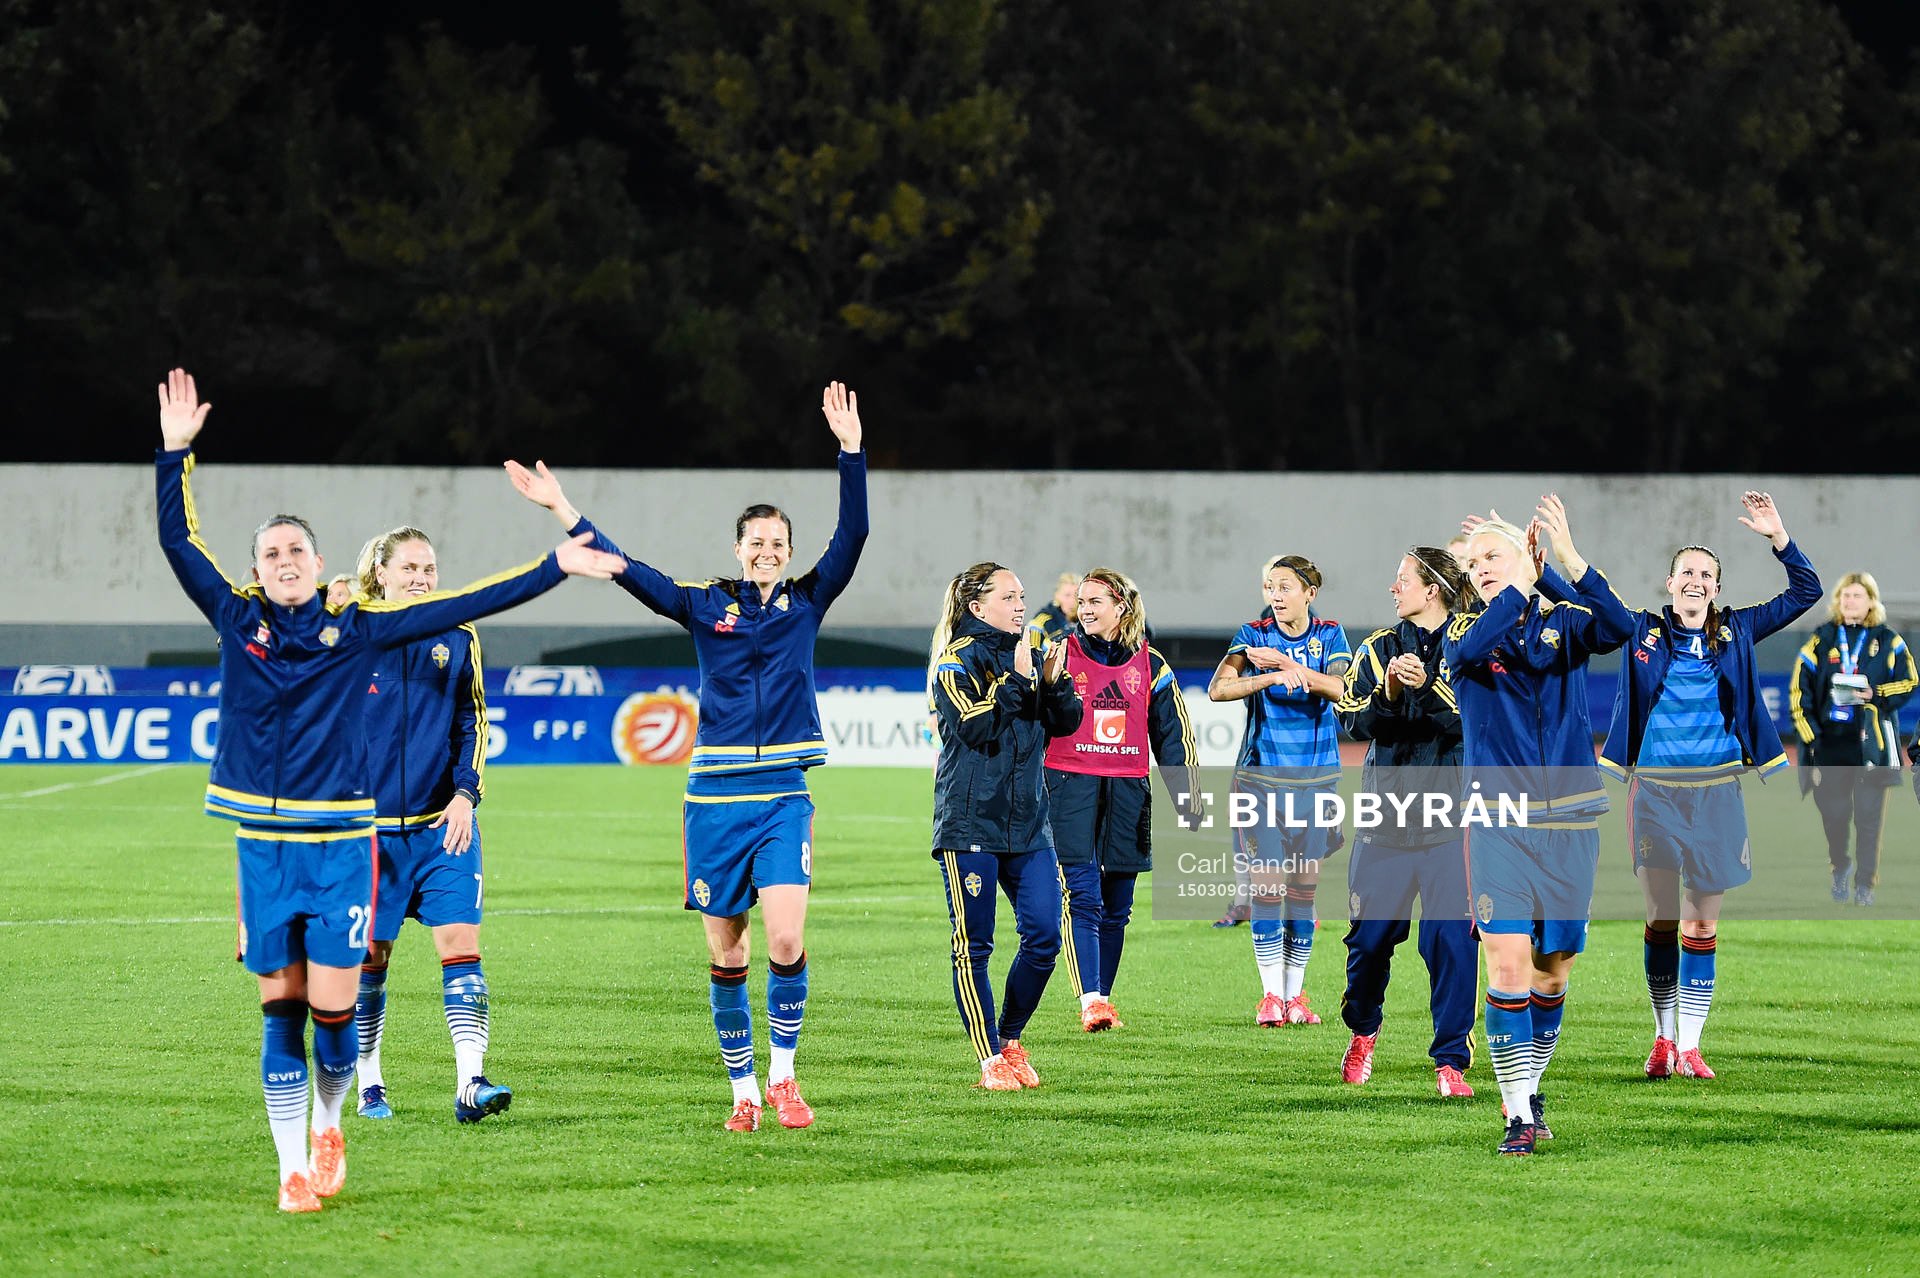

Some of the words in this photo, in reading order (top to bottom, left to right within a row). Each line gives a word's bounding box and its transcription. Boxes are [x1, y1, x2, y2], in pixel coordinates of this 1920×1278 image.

[1690, 635, 1704, 660] 4
[1634, 648, 1650, 665] ICA
[1091, 700, 1131, 709] adidas
[532, 719, 588, 741] FPF
[1075, 743, 1120, 755] SVENSKA
[1120, 745, 1140, 755] SPEL
[719, 1029, 749, 1039] SVFF
[267, 1070, 301, 1083] SVFF
